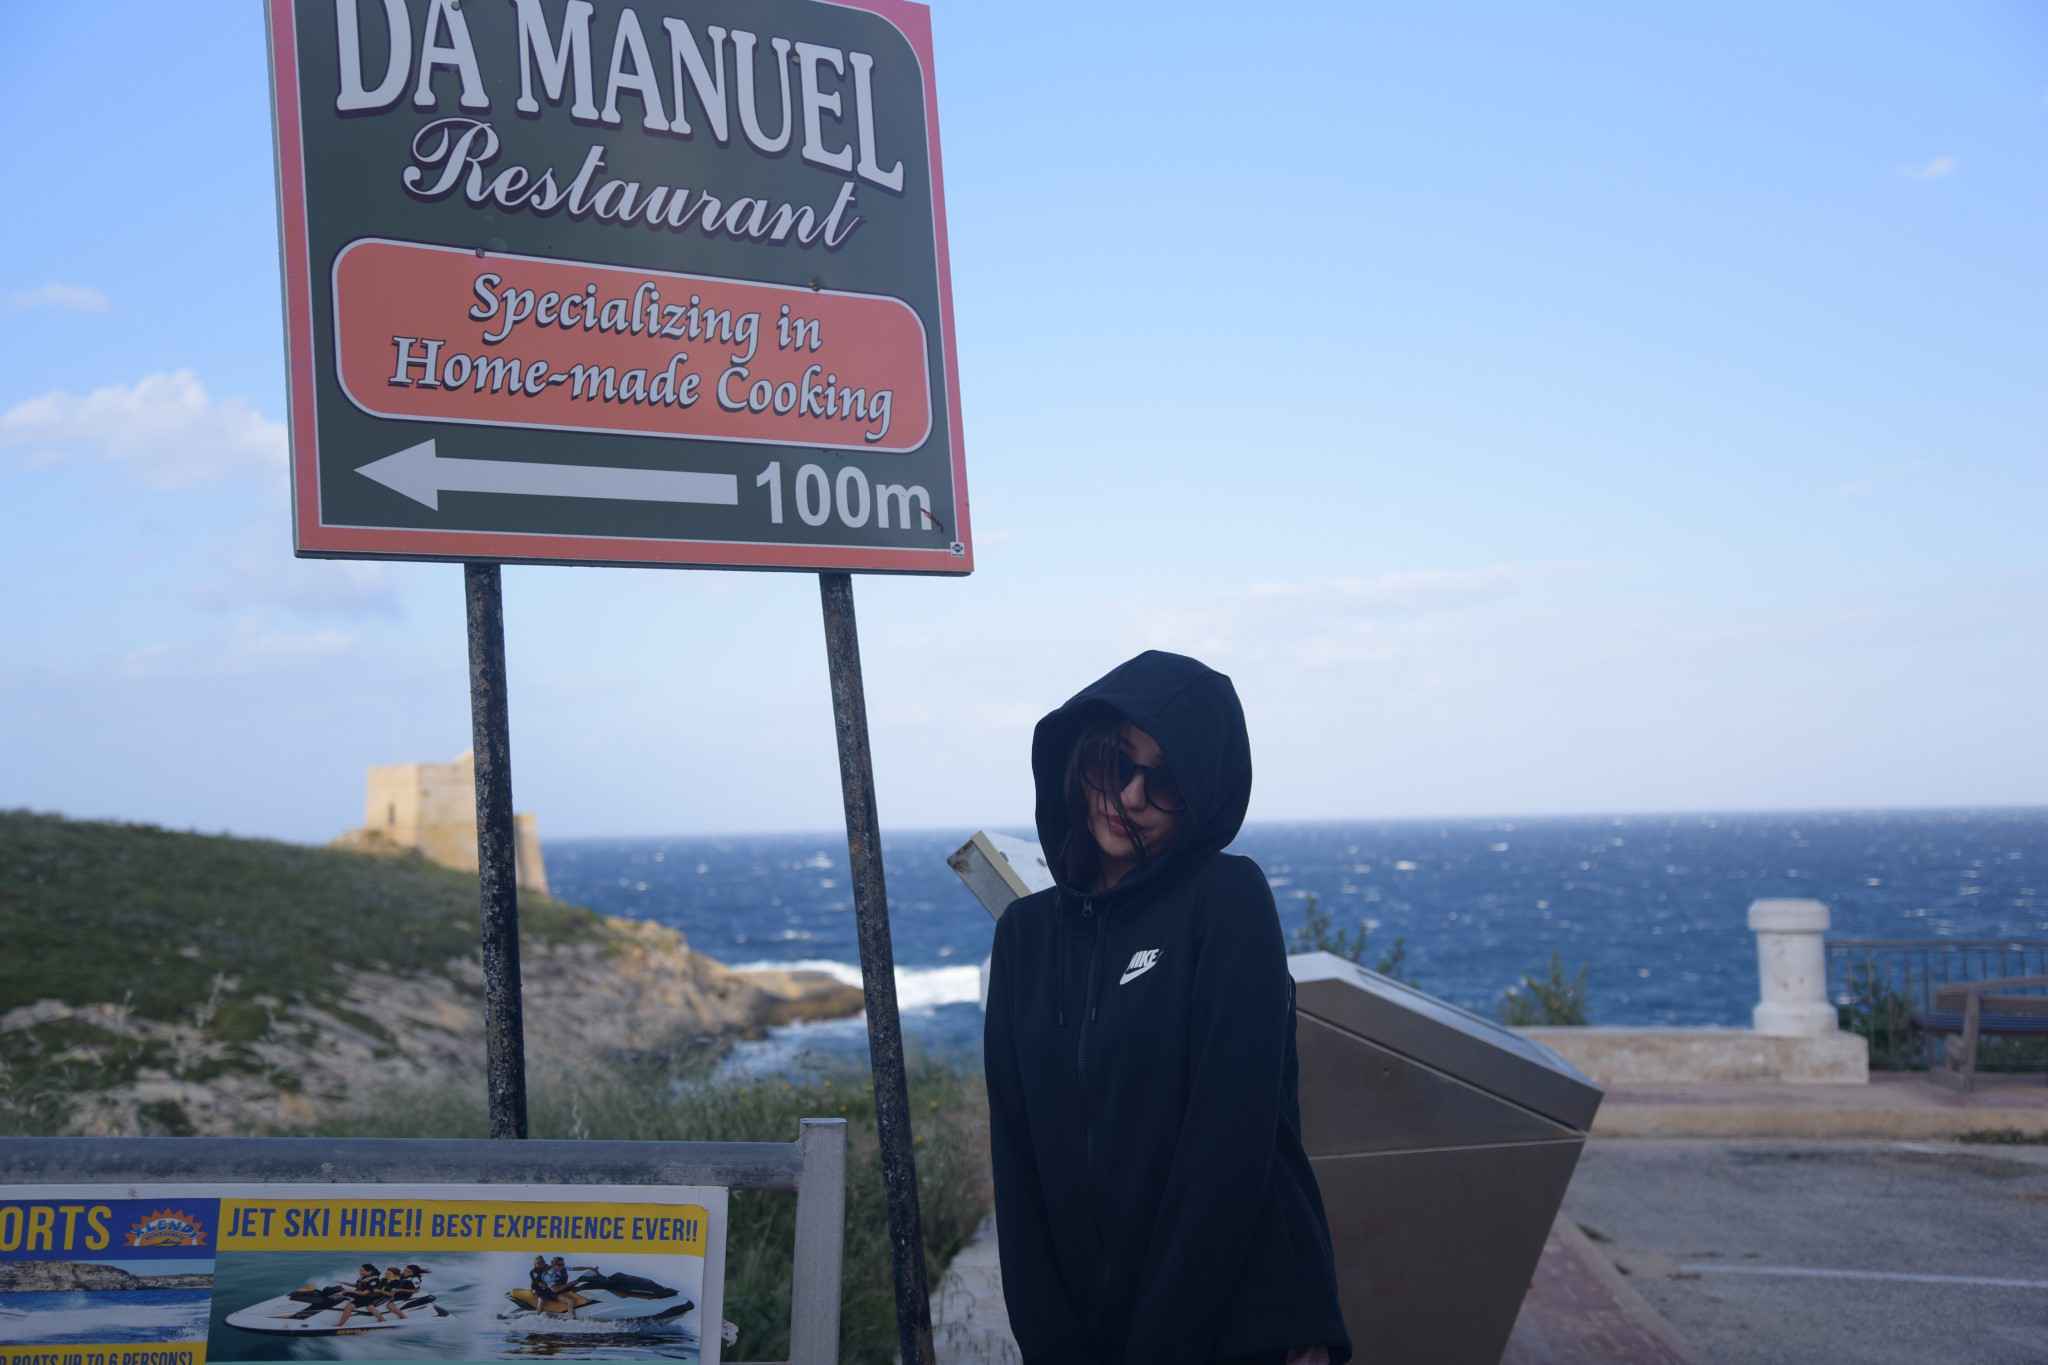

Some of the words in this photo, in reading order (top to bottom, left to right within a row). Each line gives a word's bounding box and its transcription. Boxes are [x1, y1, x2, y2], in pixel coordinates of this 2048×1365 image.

[335, 0, 490, 112] DA
[512, 0, 905, 192] MANUEL
[402, 118, 864, 247] Restaurant
[470, 272, 761, 363] Specializing
[777, 304, 822, 351] in
[389, 335, 699, 407] Home-made
[716, 364, 893, 441] Cooking
[755, 460, 934, 532] 100m
[1127, 948, 1160, 969] NIKE
[0, 1205, 112, 1251] ORTS
[227, 1208, 276, 1237] JET
[283, 1208, 330, 1237] SKI
[339, 1208, 423, 1237] HIRE!!
[431, 1214, 488, 1238] BEST
[493, 1215, 625, 1240] EXPERIENCE
[631, 1217, 699, 1242] EVER!!
